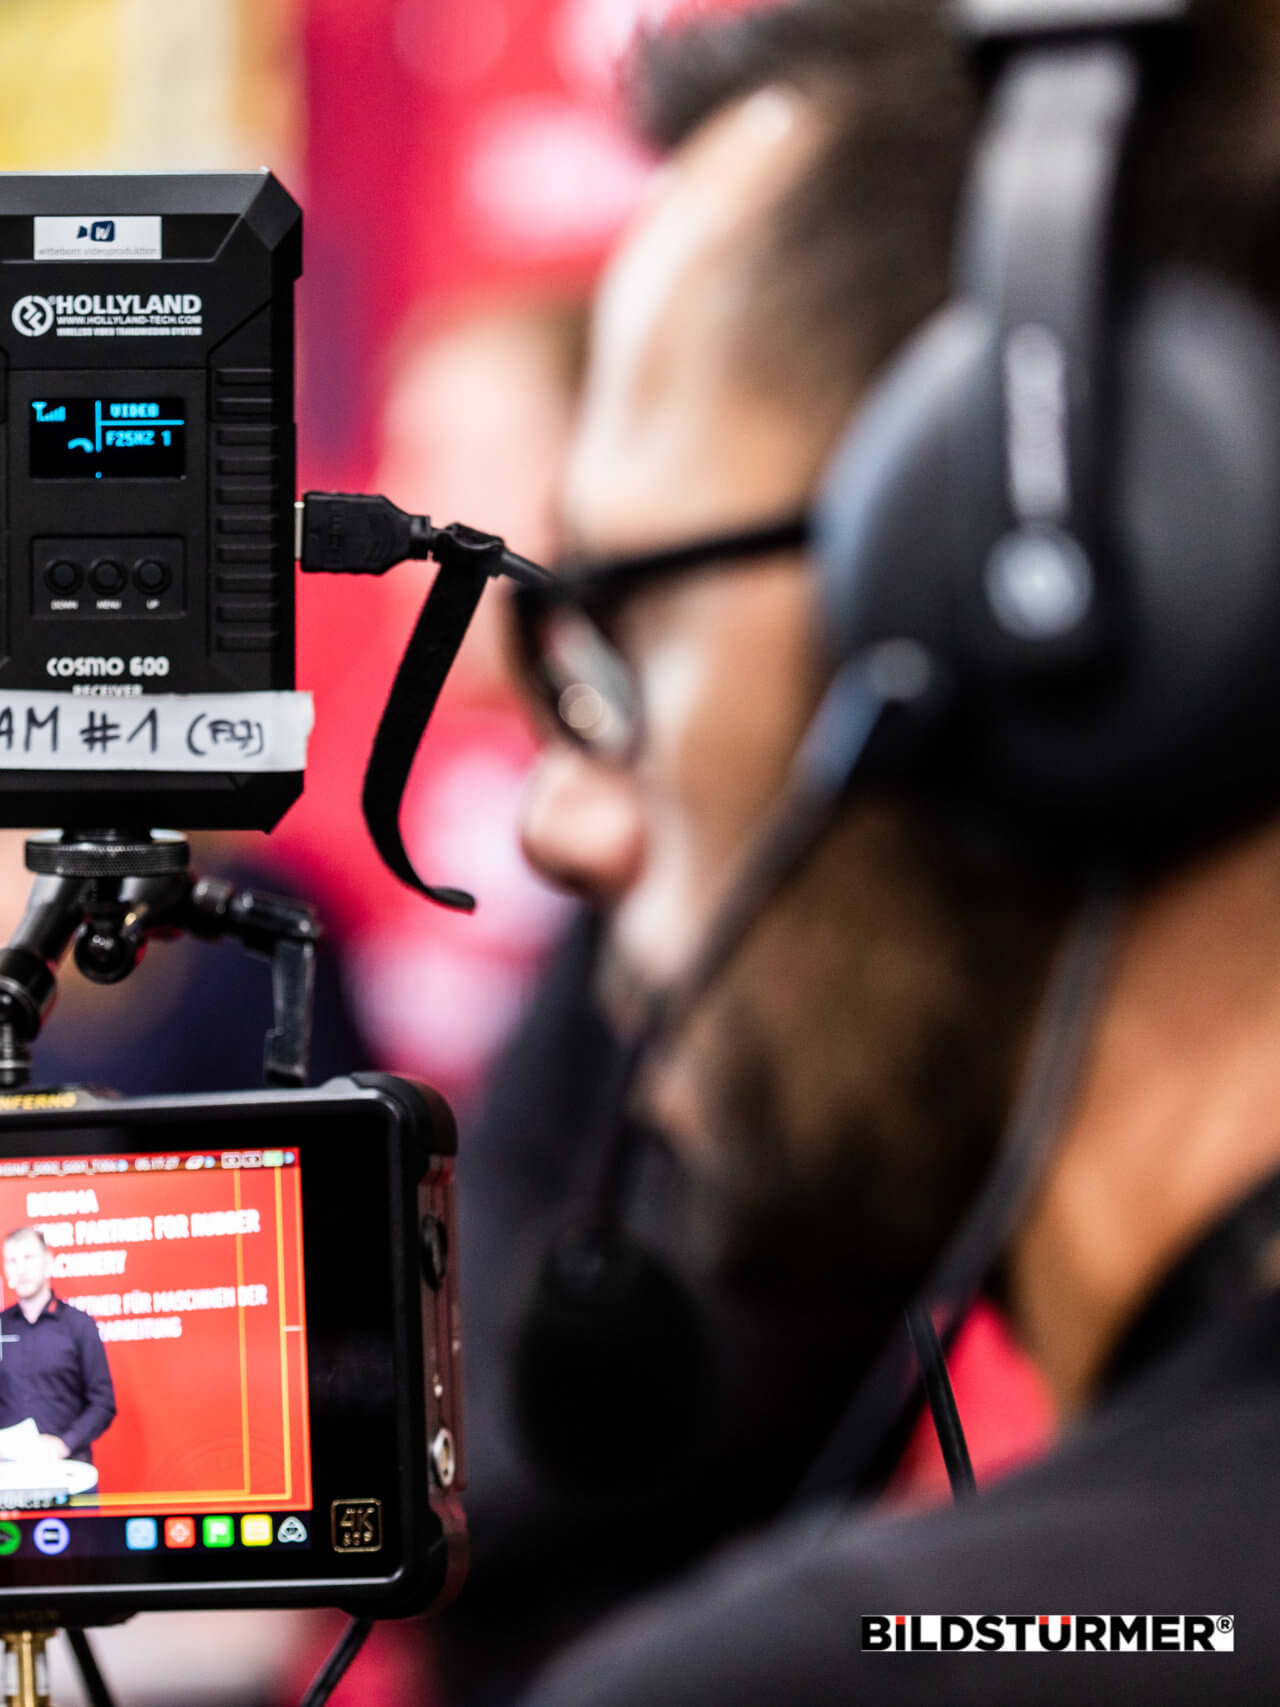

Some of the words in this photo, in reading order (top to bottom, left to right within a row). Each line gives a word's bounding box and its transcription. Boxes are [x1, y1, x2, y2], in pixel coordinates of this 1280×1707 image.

[56, 294, 202, 315] HOLLYLAND
[110, 402, 159, 418] VIDEO
[95, 599, 122, 610] MENU
[146, 599, 160, 610] UP
[46, 656, 125, 677] COSMO
[129, 656, 170, 677] 600
[75, 1216, 153, 1245] PARTNER
